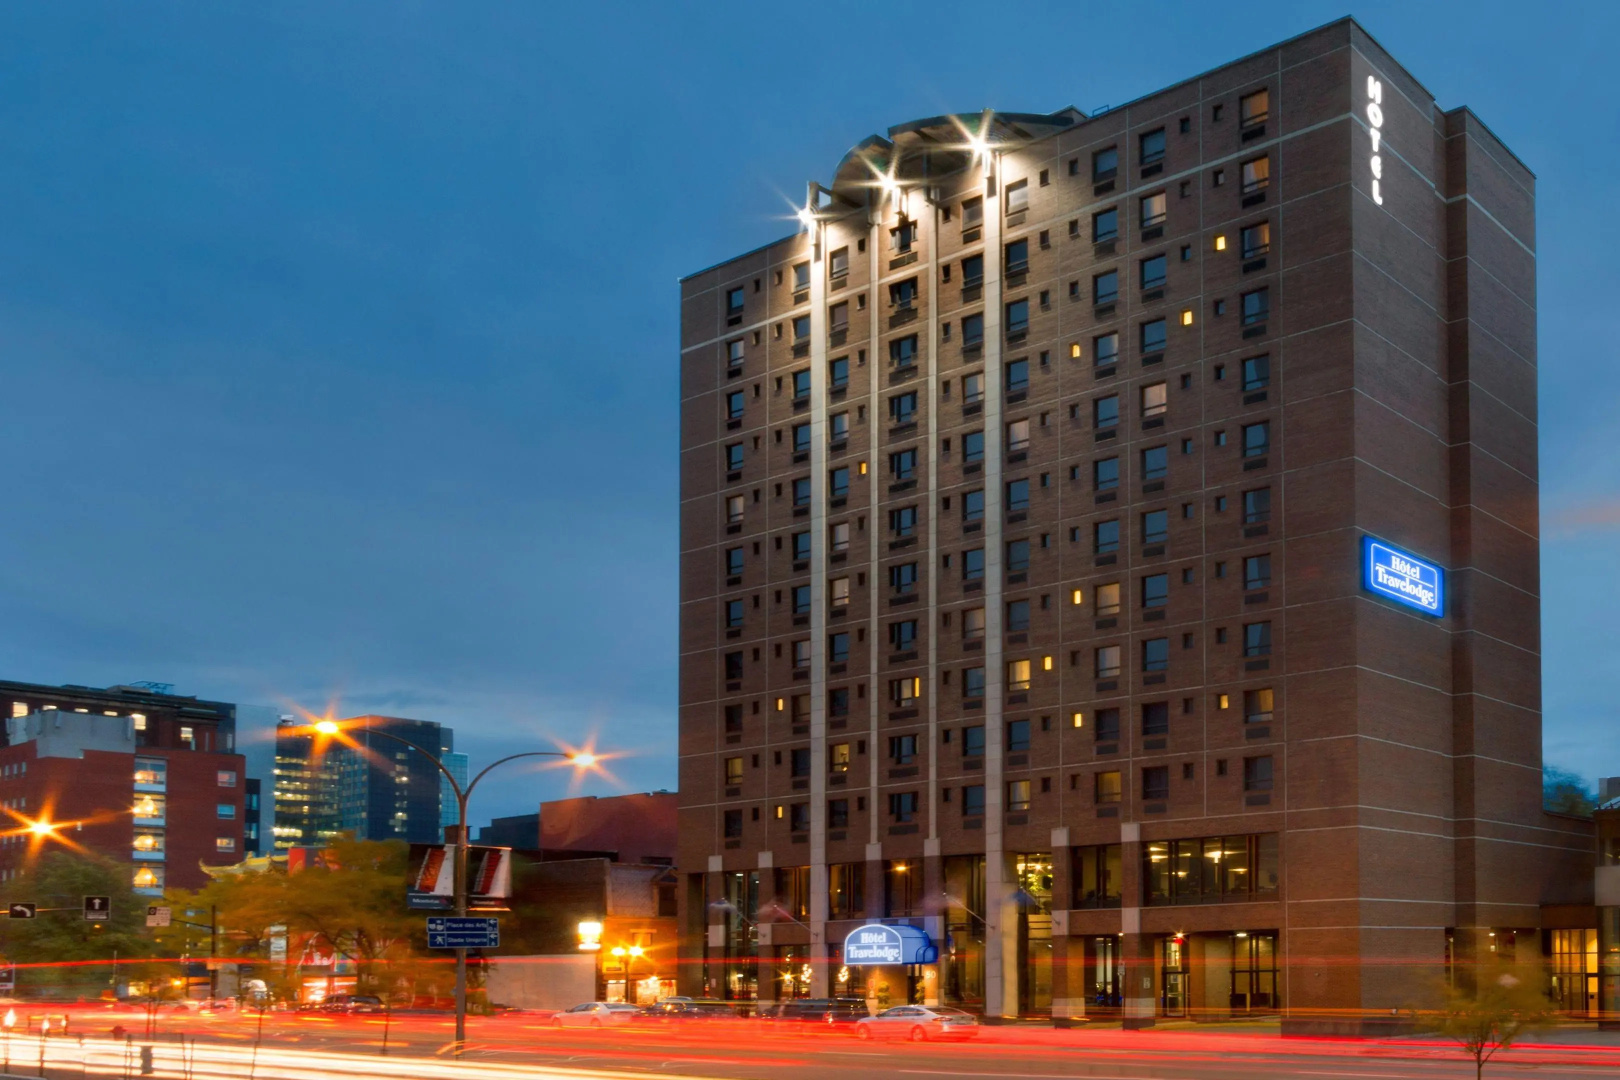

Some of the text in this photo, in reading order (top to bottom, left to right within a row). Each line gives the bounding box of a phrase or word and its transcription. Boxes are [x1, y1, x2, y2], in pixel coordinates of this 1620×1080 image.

[1366, 75, 1383, 206] HOTEL
[1391, 555, 1420, 579] Hôtel
[1375, 566, 1434, 605] Travelodge
[860, 932, 887, 944] Hôtel
[847, 944, 900, 962] Travelodge
